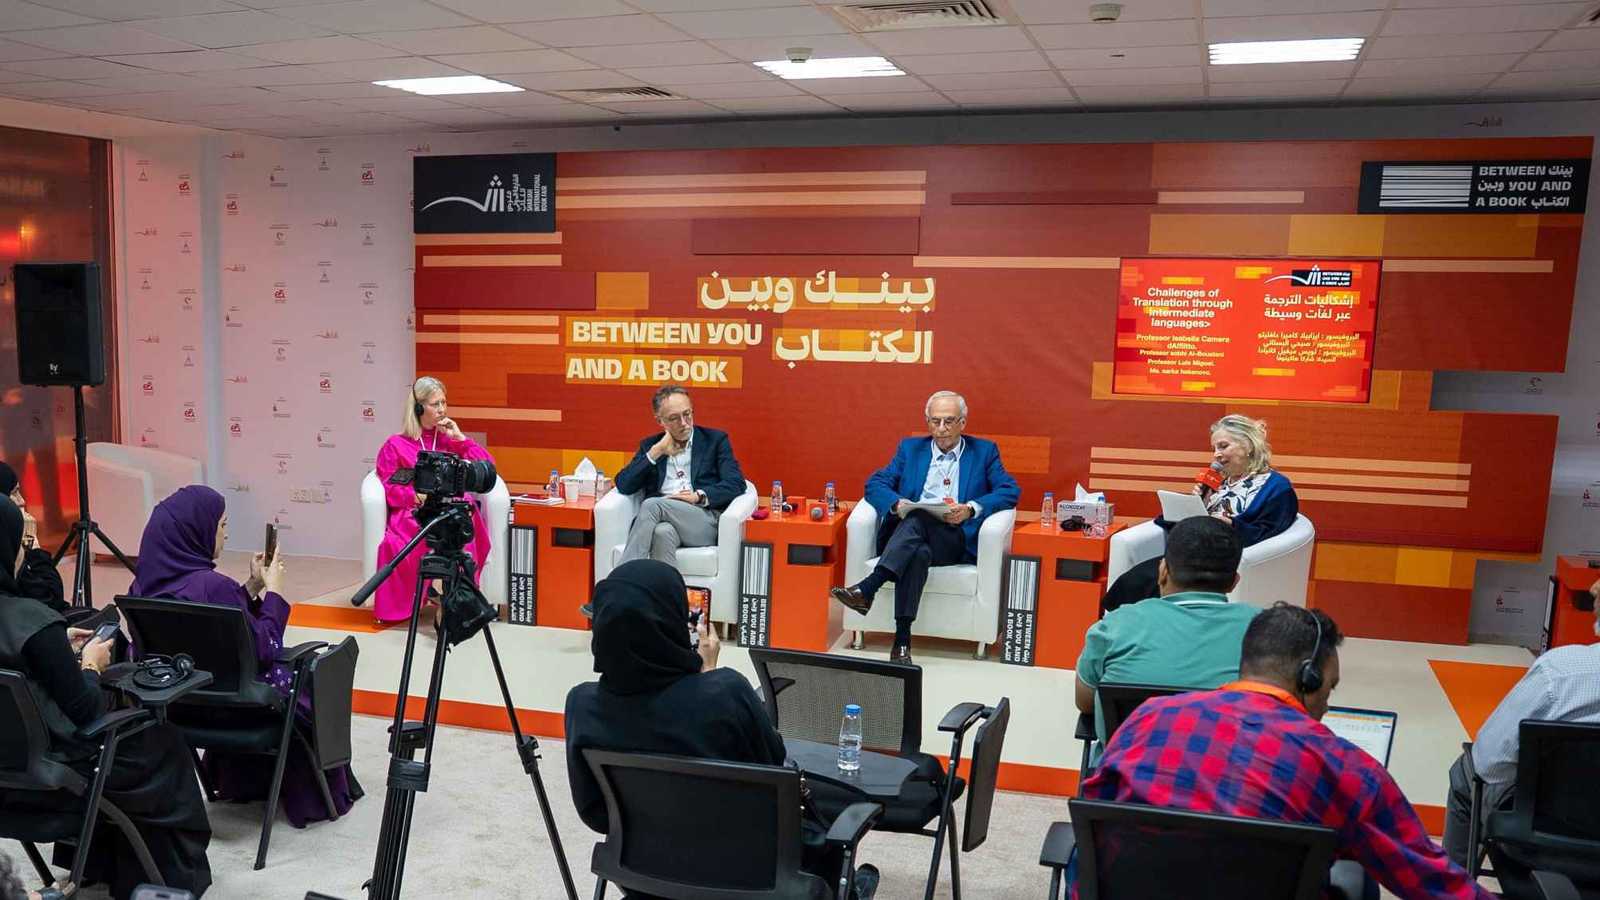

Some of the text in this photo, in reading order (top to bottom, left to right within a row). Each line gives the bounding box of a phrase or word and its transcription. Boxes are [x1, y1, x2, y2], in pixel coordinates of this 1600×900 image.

[1479, 166, 1546, 177] BETWEEN
[1548, 165, 1574, 178] بينك
[1477, 180, 1505, 193] وبين
[1508, 181, 1572, 192] YOU AND
[1475, 197, 1528, 207] A BOOK
[1531, 196, 1570, 210] الكتاب
[701, 271, 794, 313] وبين
[1147, 288, 1220, 299] Challenges of
[1132, 297, 1233, 310] Translation through
[572, 321, 763, 346] BETWEEN YOU
[567, 358, 728, 383] AND A BOOK
[1024, 614, 1033, 649] BETWEEN
